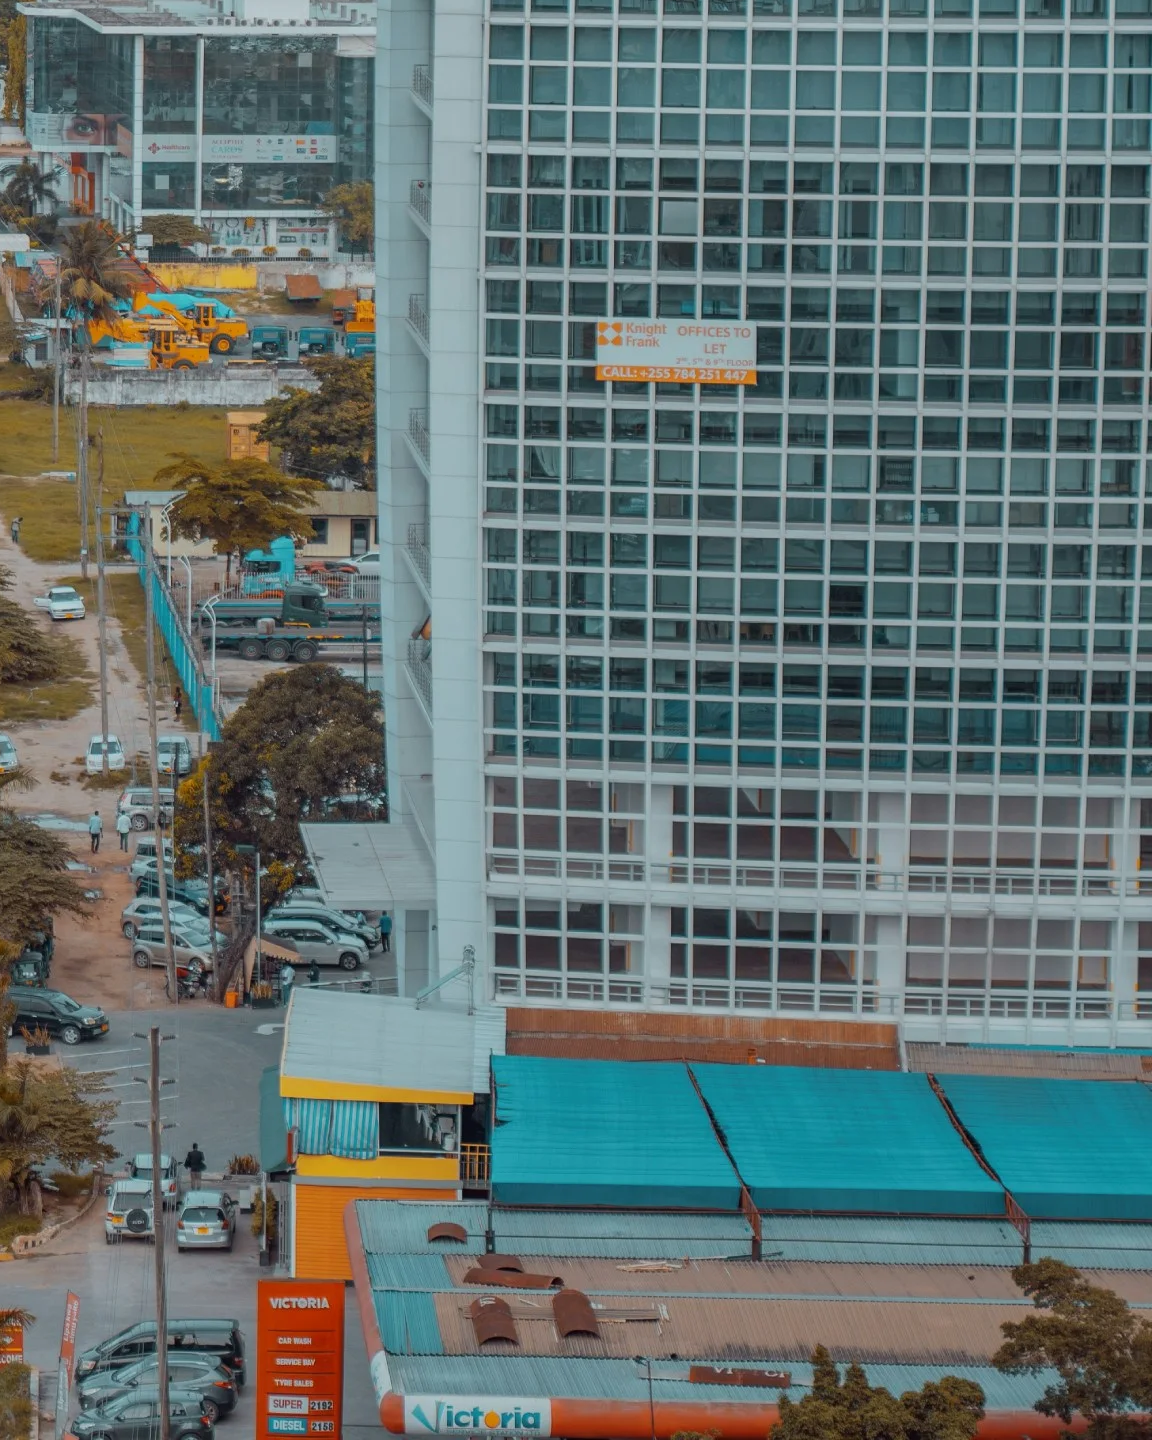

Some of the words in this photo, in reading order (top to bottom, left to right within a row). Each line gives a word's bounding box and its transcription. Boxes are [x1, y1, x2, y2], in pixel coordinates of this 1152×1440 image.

[626, 323, 667, 335] Knight
[677, 326, 730, 338] OFFICES
[734, 328, 751, 339] TO
[626, 336, 660, 347] Frank
[704, 344, 726, 354] LET
[726, 359, 753, 367] FLOOR
[602, 367, 637, 378] CALL:
[640, 368, 670, 379] +255
[674, 369, 696, 379] 784
[699, 370, 720, 380] 251
[724, 371, 747, 381] 447
[269, 1297, 330, 1309] VICTORIA
[278, 1337, 292, 1345] CAR
[293, 1337, 312, 1345] WASH
[276, 1358, 301, 1366] SERVICE
[303, 1358, 315, 1366] BAY
[274, 1379, 292, 1387] TYRE
[294, 1379, 314, 1388] SALES
[273, 1399, 303, 1409] SUPER
[310, 1400, 333, 1410] 2192
[411, 1399, 540, 1434] Victoria
[273, 1419, 305, 1431] DIESEL
[312, 1422, 334, 1432] 2158
